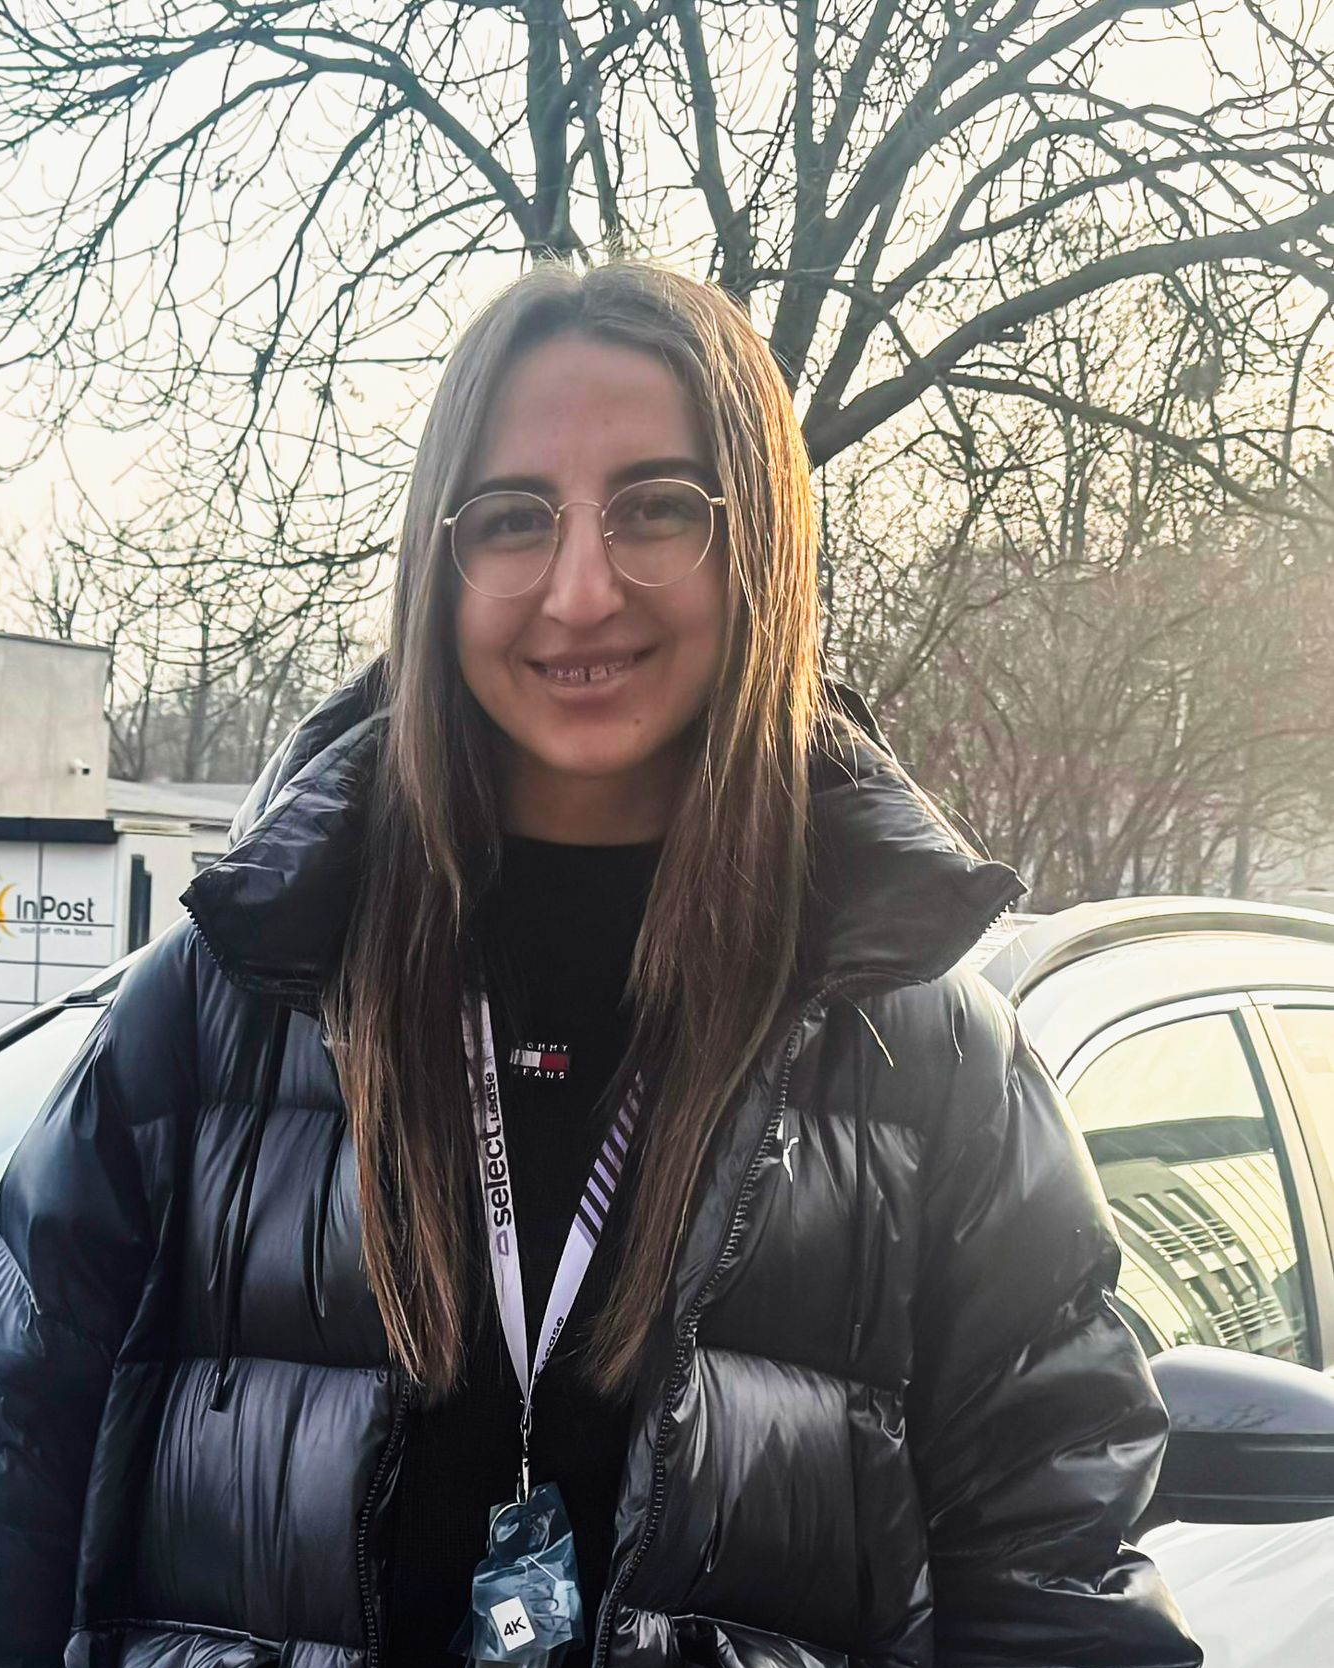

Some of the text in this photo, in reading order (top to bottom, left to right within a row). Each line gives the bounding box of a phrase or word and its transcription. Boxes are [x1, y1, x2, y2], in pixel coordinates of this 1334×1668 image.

[17, 895, 94, 922] InPost
[526, 1042, 568, 1052] OMMY
[479, 1124, 512, 1228] select
[503, 1616, 526, 1637] 4K
